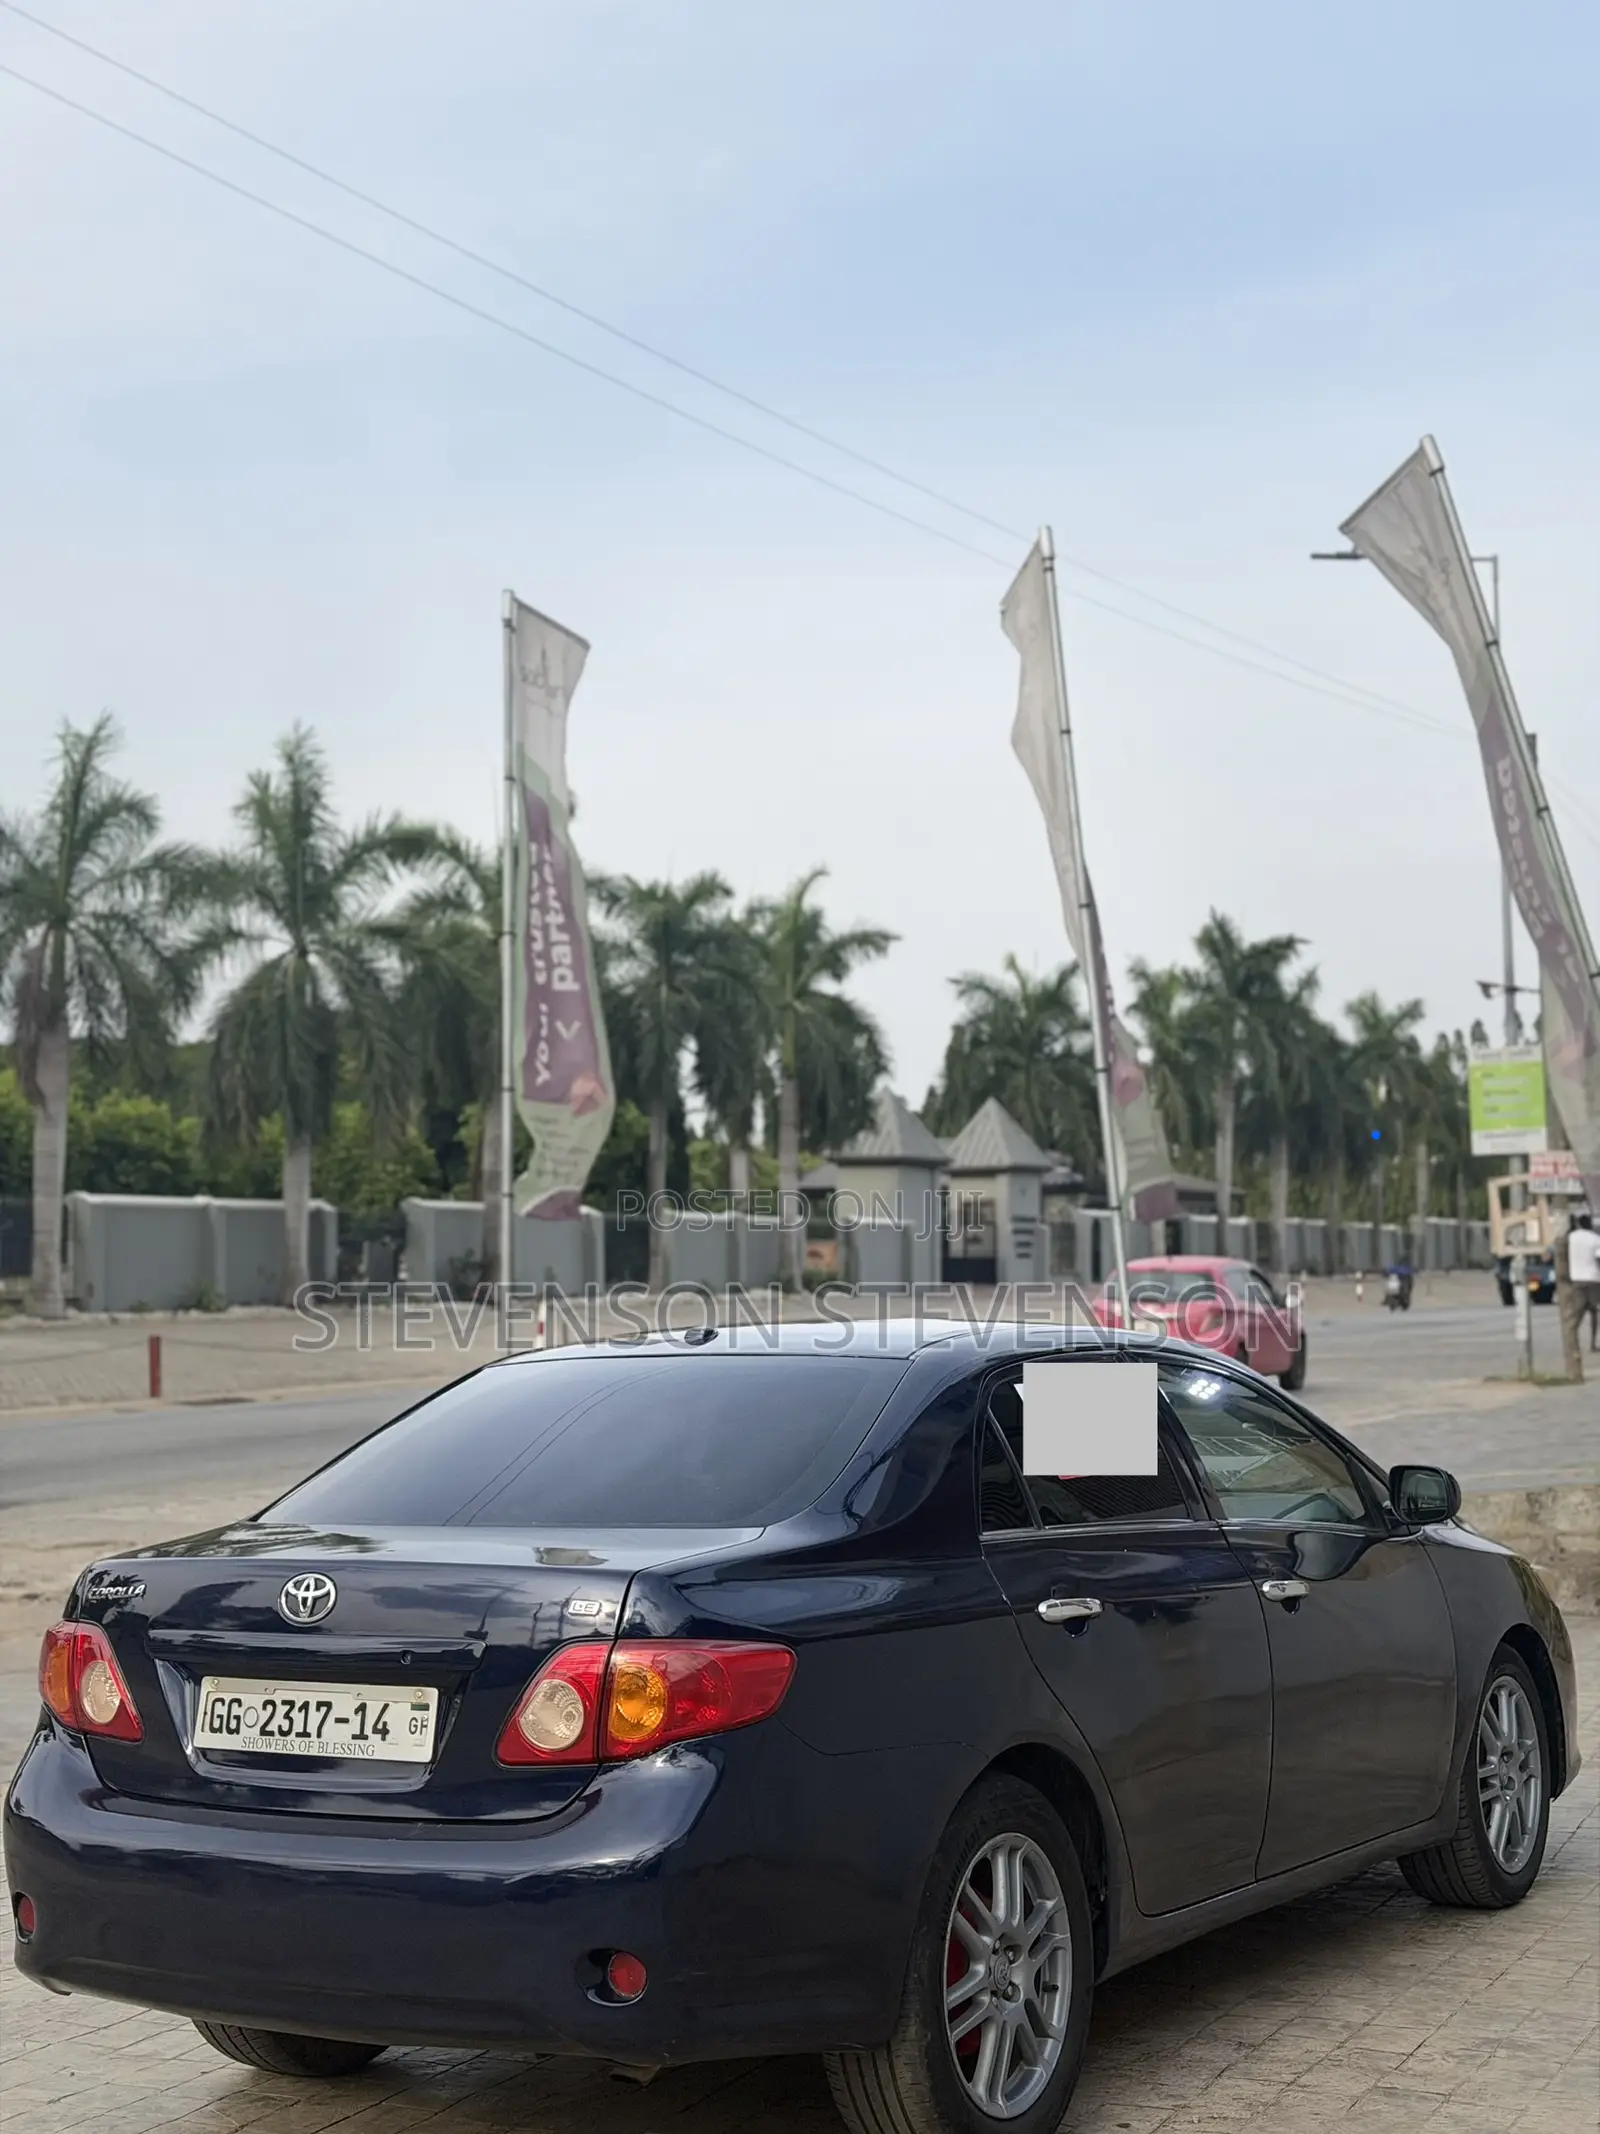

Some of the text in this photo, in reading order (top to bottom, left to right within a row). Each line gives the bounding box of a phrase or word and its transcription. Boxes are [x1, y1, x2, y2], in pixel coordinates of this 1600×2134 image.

[89, 1584, 147, 1600] COROLLA
[208, 1697, 243, 1735] GG
[258, 1699, 390, 1742] 2317-14
[240, 1736, 375, 1757] SHOWERS OF BLESSING
